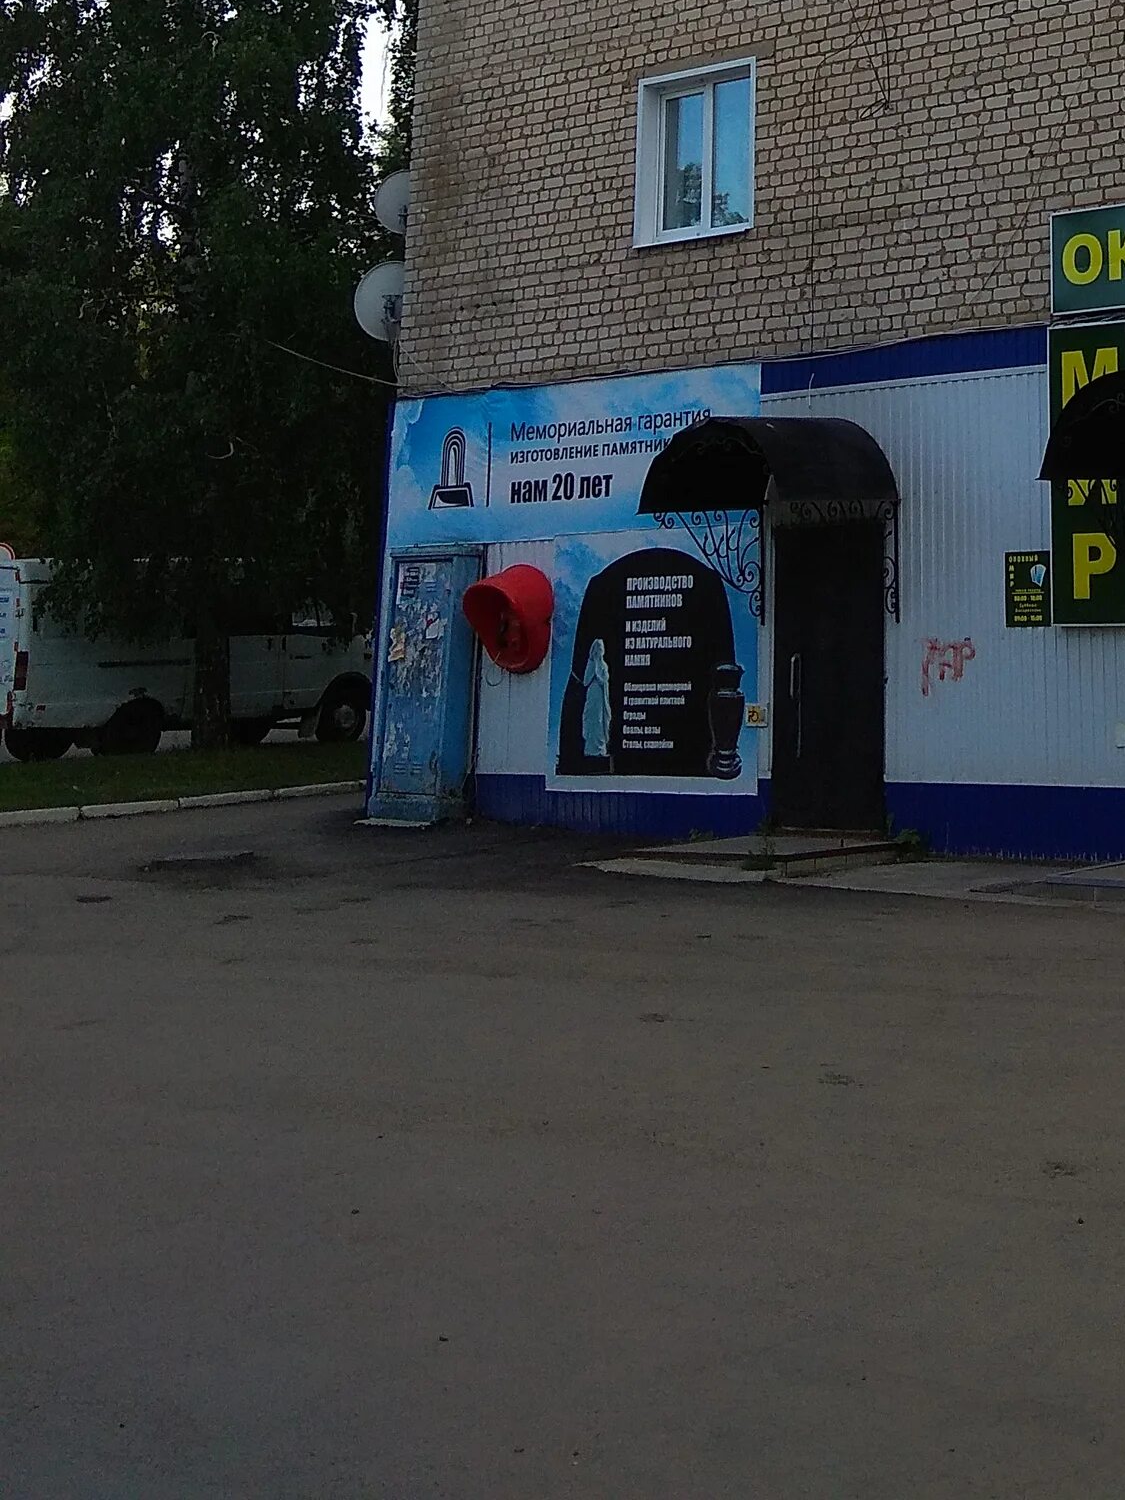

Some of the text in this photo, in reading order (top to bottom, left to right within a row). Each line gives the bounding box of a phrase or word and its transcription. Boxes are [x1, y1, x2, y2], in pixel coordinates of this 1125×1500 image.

[510, 408, 711, 444] Мемориальная гарантия
[510, 444, 599, 464] ИЗГОТОВЛЕНИЕ
[510, 472, 613, 504] нам 20 лет
[626, 575, 694, 591] ПРОИЗВОДСТВО
[626, 594, 683, 609] ПАМЯТНИКОВ
[632, 617, 666, 633] ИЗДЕЛИЙ
[625, 636, 692, 649] ИЗ НАТУРАЛЬНОГО
